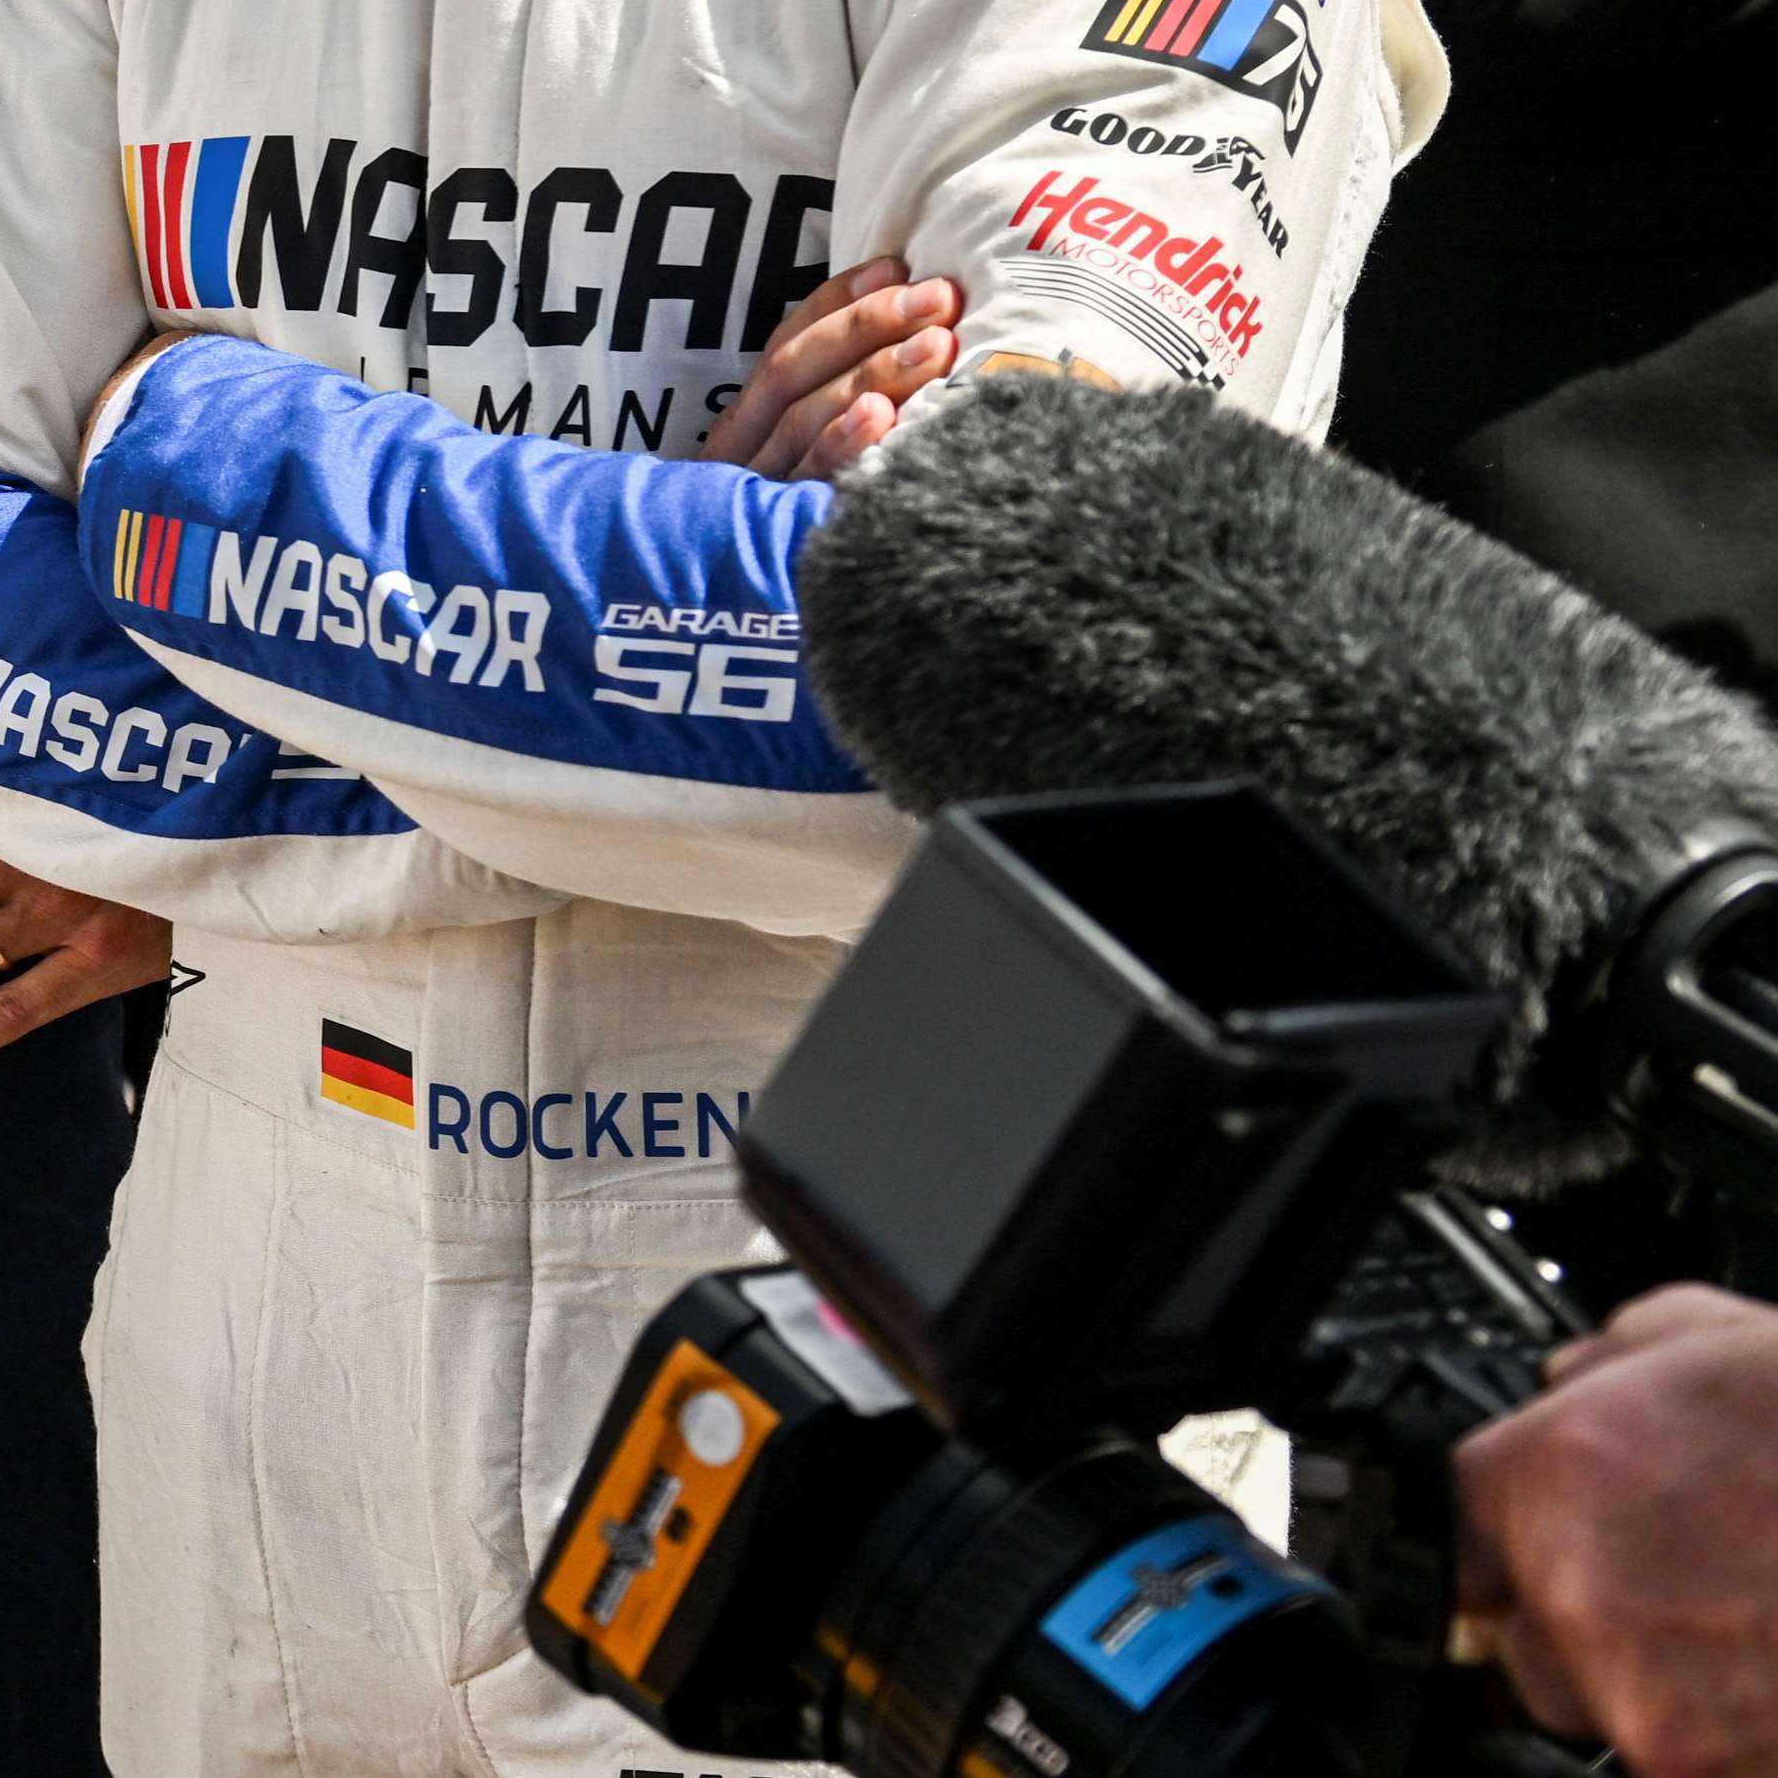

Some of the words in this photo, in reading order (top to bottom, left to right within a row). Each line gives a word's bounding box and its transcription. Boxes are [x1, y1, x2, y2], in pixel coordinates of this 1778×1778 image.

[1008, 170, 1264, 360] Hendrick
[1048, 236, 1241, 378] MOTORSPORTS
[210, 531, 551, 693] NASCAR
[602, 603, 801, 640] GARAGE
[592, 634, 799, 722] 56
[428, 1081, 749, 1159] ROCKEN
